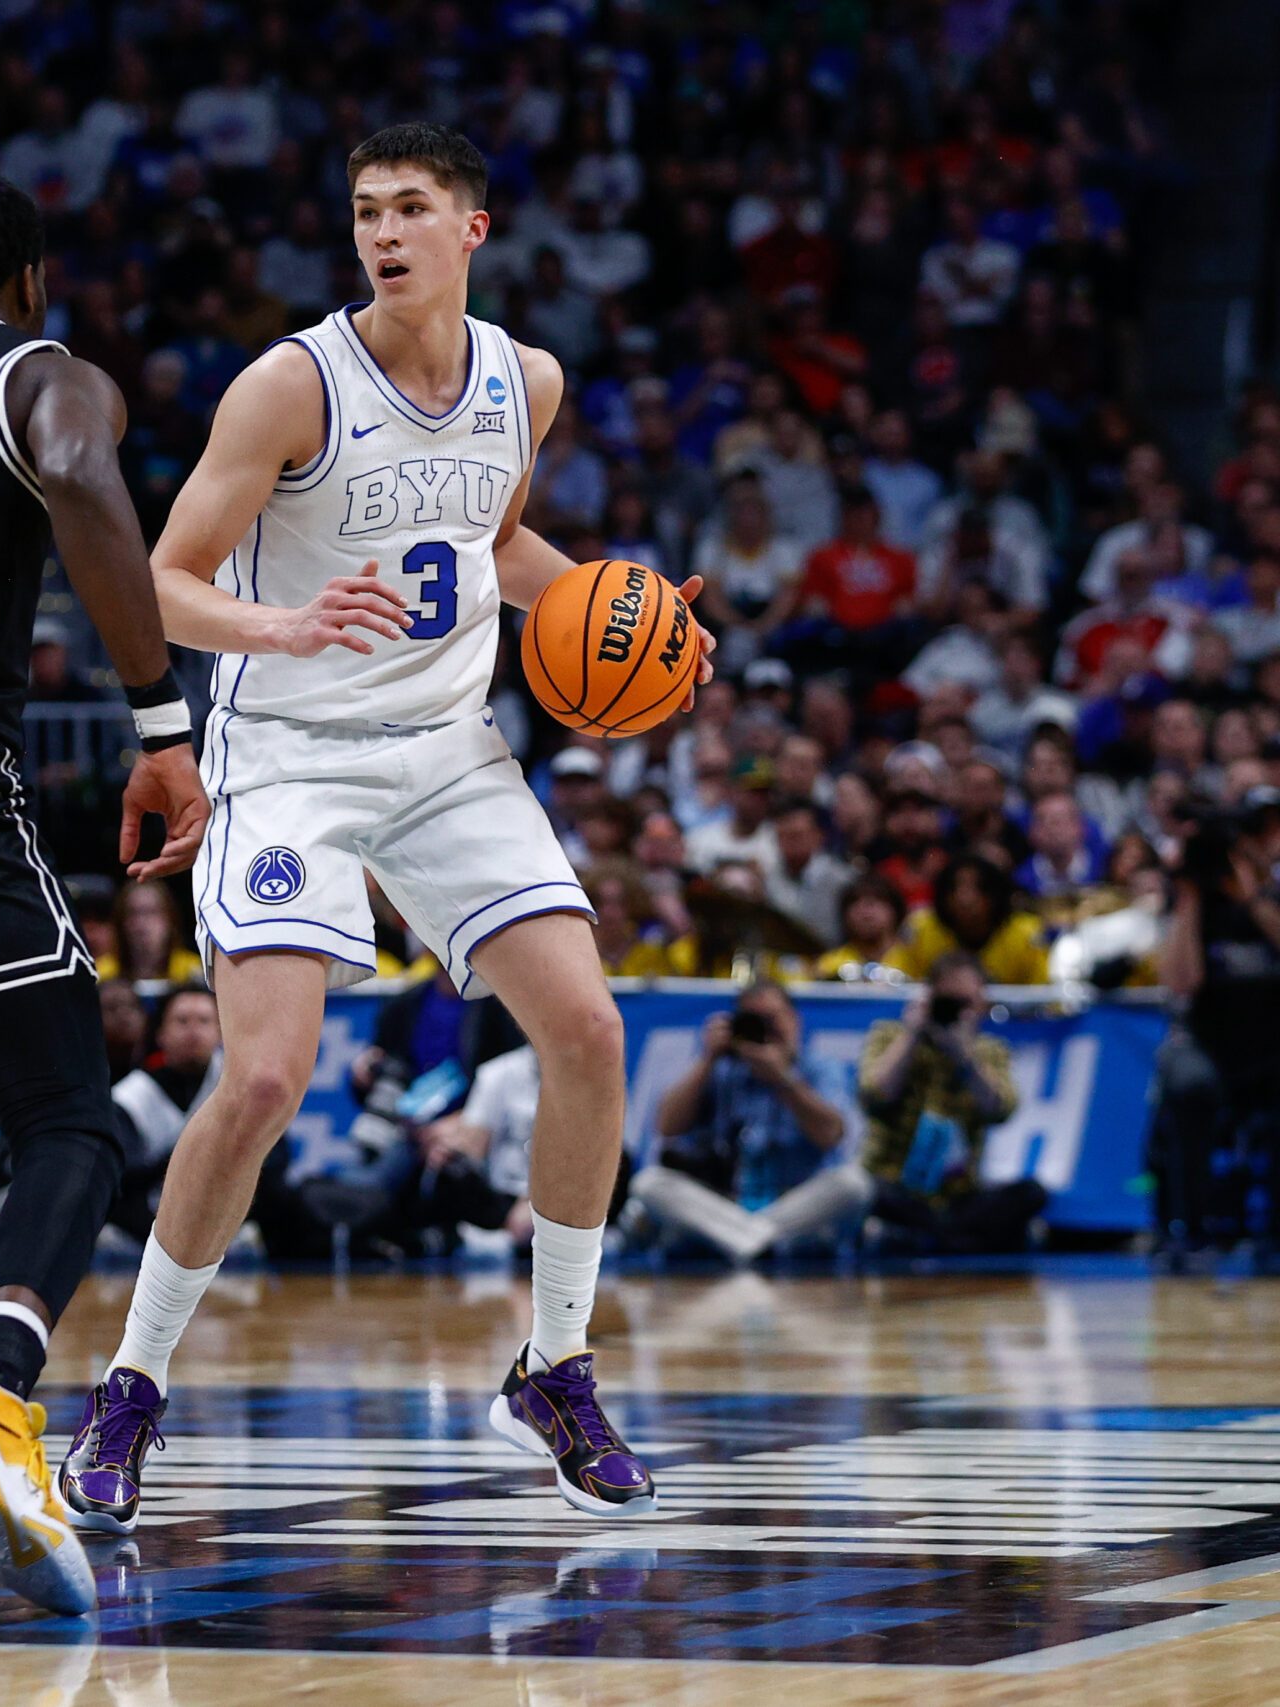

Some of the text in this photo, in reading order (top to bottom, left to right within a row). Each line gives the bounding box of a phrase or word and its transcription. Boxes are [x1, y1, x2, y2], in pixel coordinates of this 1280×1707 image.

[338, 458, 510, 536] BYU
[398, 541, 458, 640] 3
[597, 566, 647, 664] Wilson
[659, 594, 689, 675] NCAA
[265, 881, 284, 894] Y
